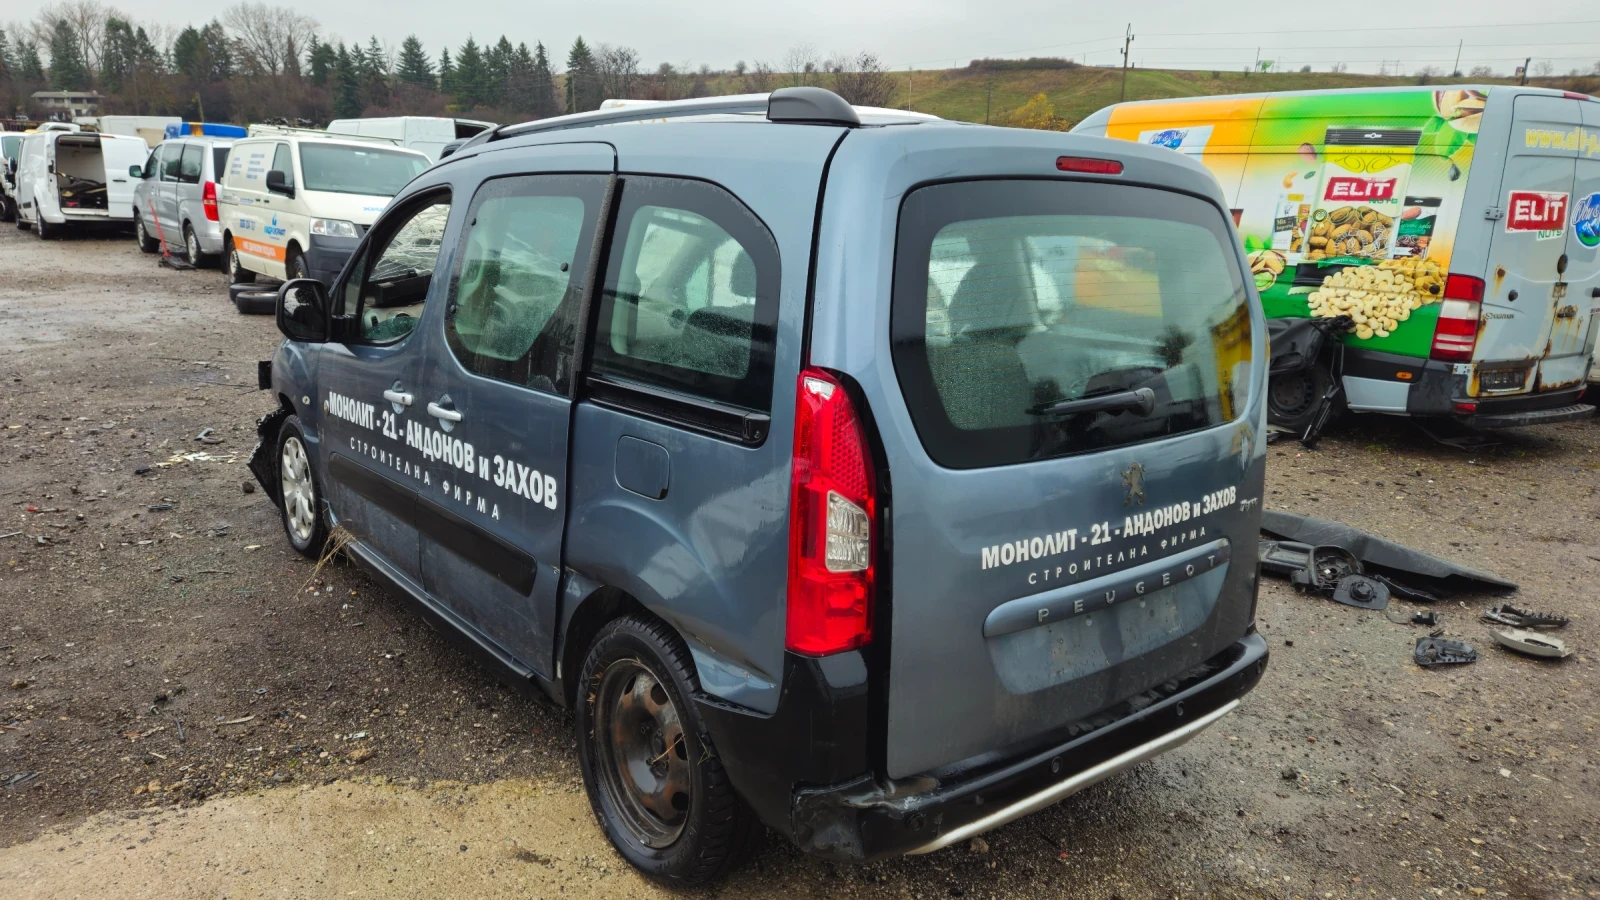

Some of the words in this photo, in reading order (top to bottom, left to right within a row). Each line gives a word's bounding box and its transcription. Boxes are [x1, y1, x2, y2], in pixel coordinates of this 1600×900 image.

[1332, 182, 1391, 197] ELIT
[1514, 199, 1563, 222] ELIT
[1538, 230, 1563, 239] NUTS
[328, 391, 375, 431] МОНОЛИТ
[382, 410, 398, 441] 21
[406, 419, 475, 474] АНДОНОВ
[478, 455, 489, 481] и
[493, 454, 558, 510] ЗАХОВ
[350, 436, 431, 486] СТРОИТЕЛНА
[442, 480, 500, 521] ФИРМА
[981, 528, 1078, 570] МОНОЛИТ
[1091, 521, 1112, 546] 21
[1123, 501, 1191, 538] АНДОНОВ
[1193, 502, 1201, 518] и
[1203, 485, 1237, 515] ЗАХОВ
[1028, 545, 1148, 586] СТРОИТЕЛНА
[1160, 526, 1207, 551] ФИРМА
[1037, 554, 1217, 623] PEUGEOT
